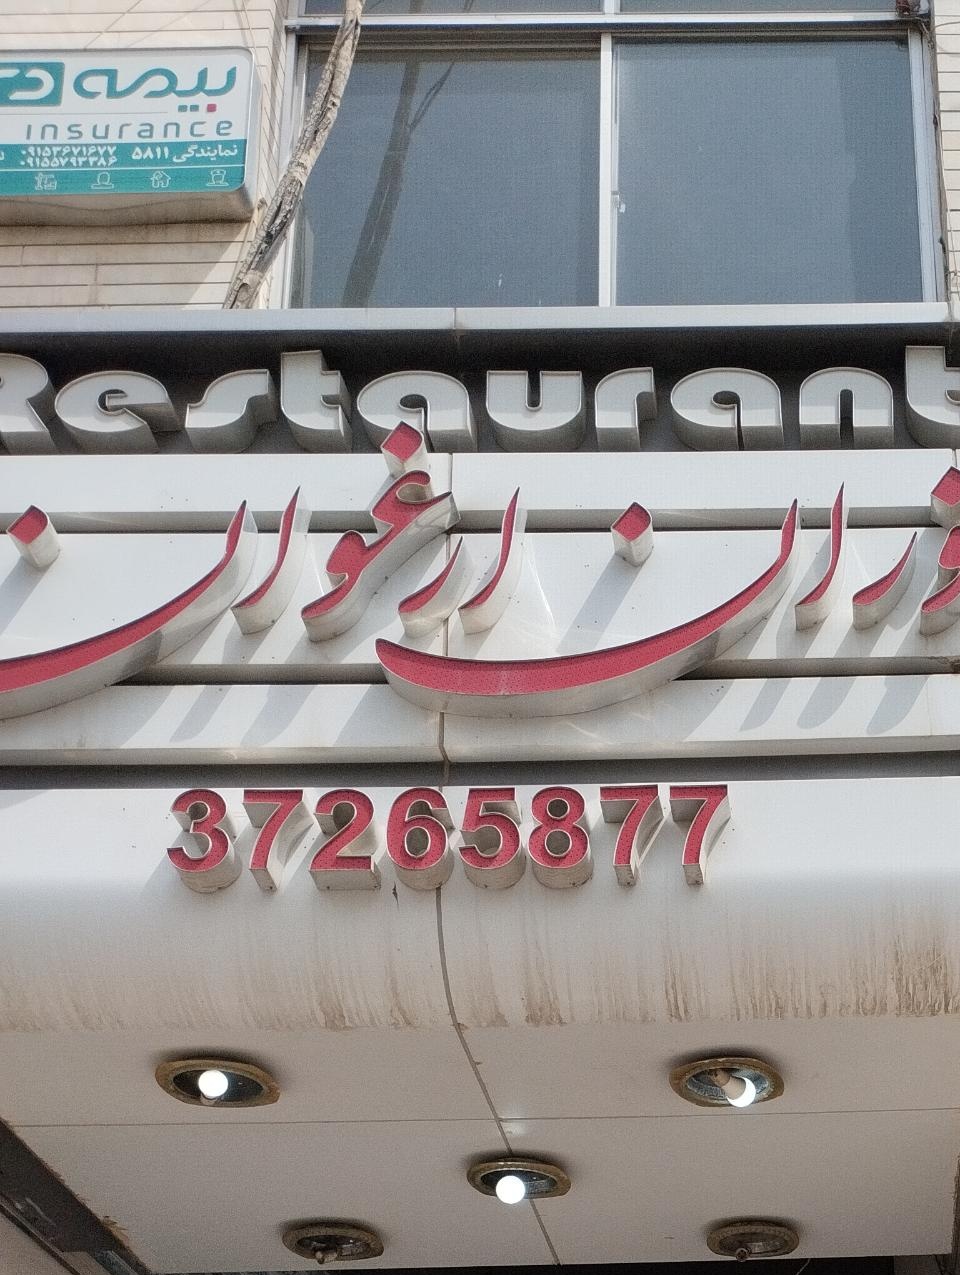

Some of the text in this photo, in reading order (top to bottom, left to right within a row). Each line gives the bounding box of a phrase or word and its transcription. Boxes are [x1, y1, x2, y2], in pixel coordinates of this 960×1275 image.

[73, 66, 236, 113] بیمه
[25, 120, 233, 140] insurance
[132, 144, 238, 163] نمایندگی ۵۸۱۱
[166, 784, 732, 888] 37265877
